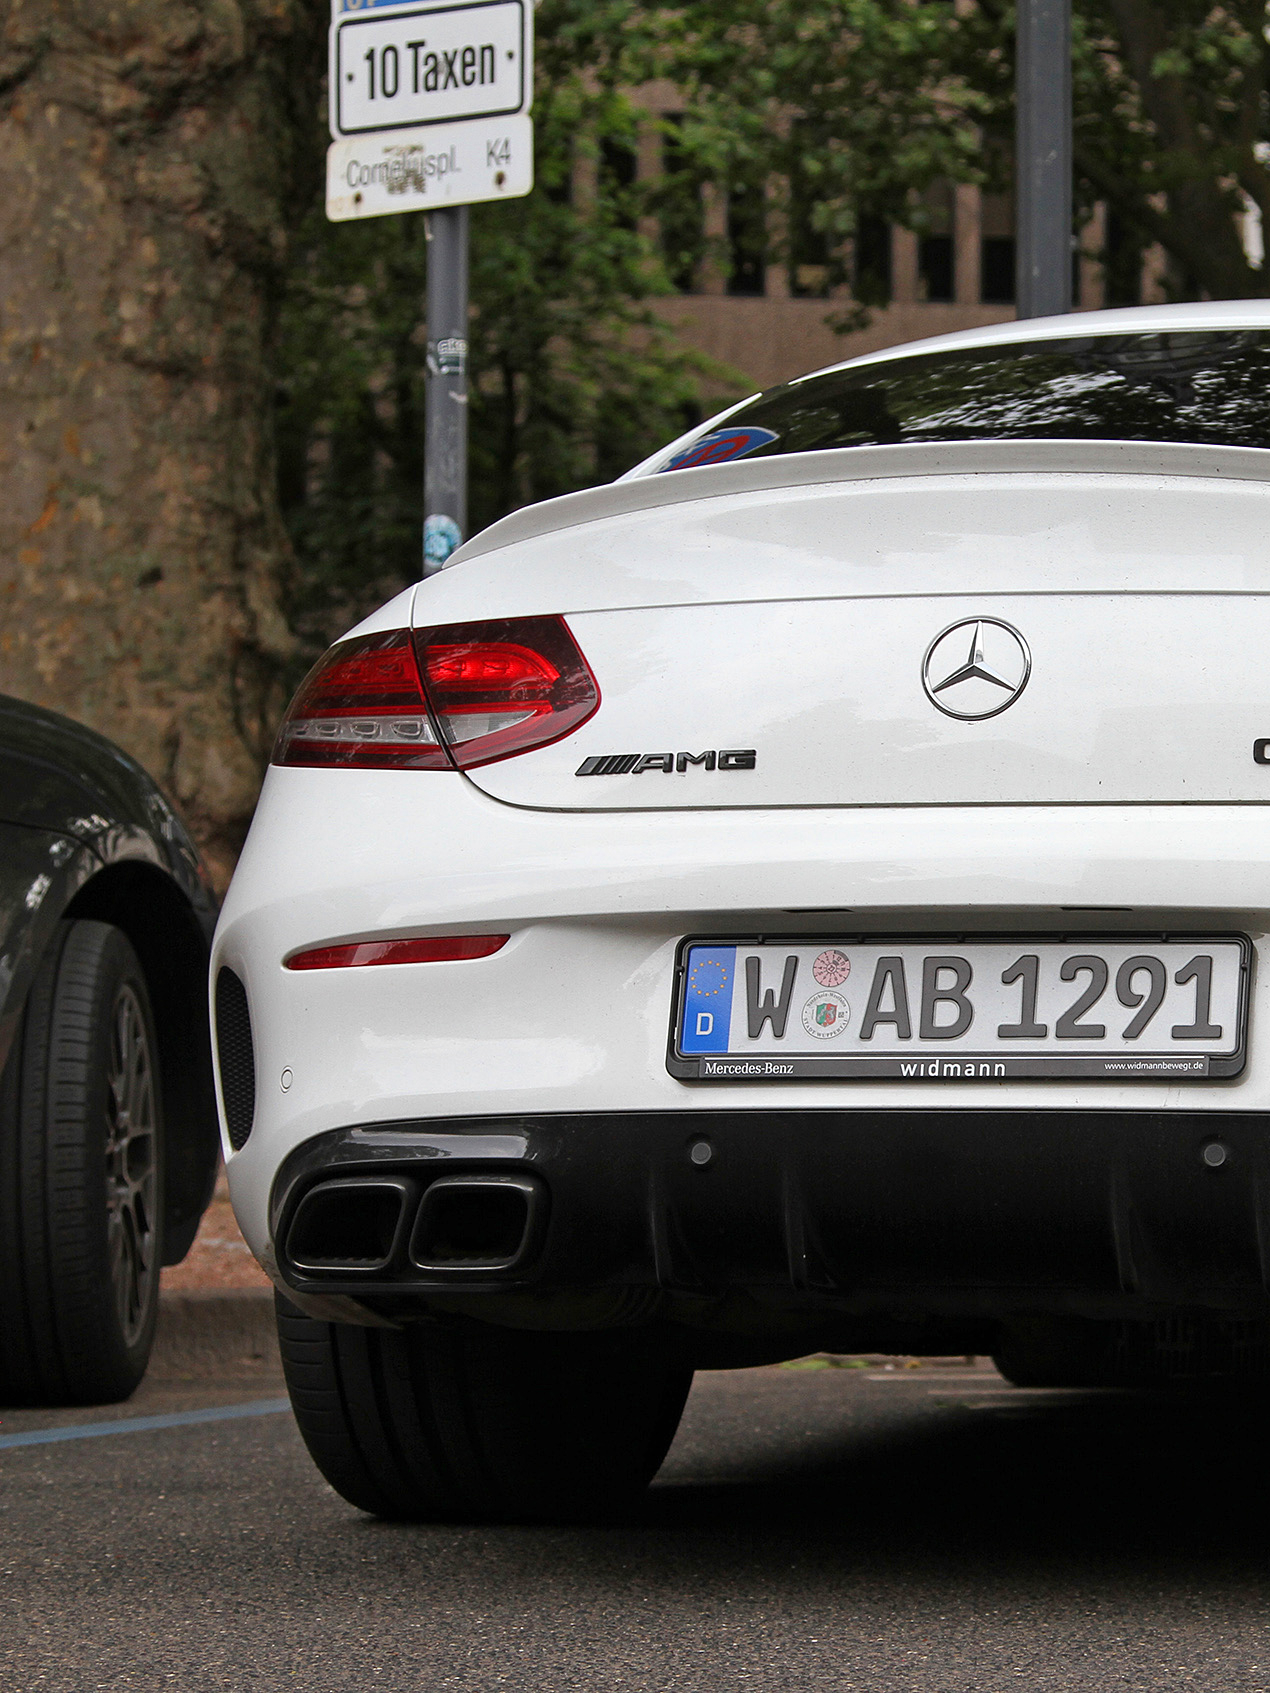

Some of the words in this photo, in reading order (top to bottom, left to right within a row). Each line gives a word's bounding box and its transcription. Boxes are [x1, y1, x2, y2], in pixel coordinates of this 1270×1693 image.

[364, 44, 400, 100] 10
[407, 40, 496, 93] Taxen
[486, 137, 512, 167] K4
[631, 749, 757, 774] AMG
[745, 956, 798, 1039] W
[859, 955, 974, 1040] AB
[997, 954, 1223, 1040] 1291
[695, 1012, 714, 1036] D
[704, 1061, 795, 1076] Mercedes-Benz
[900, 1060, 1006, 1077] widmann
[1104, 1061, 1204, 1072] www.widmannbewegt.de
